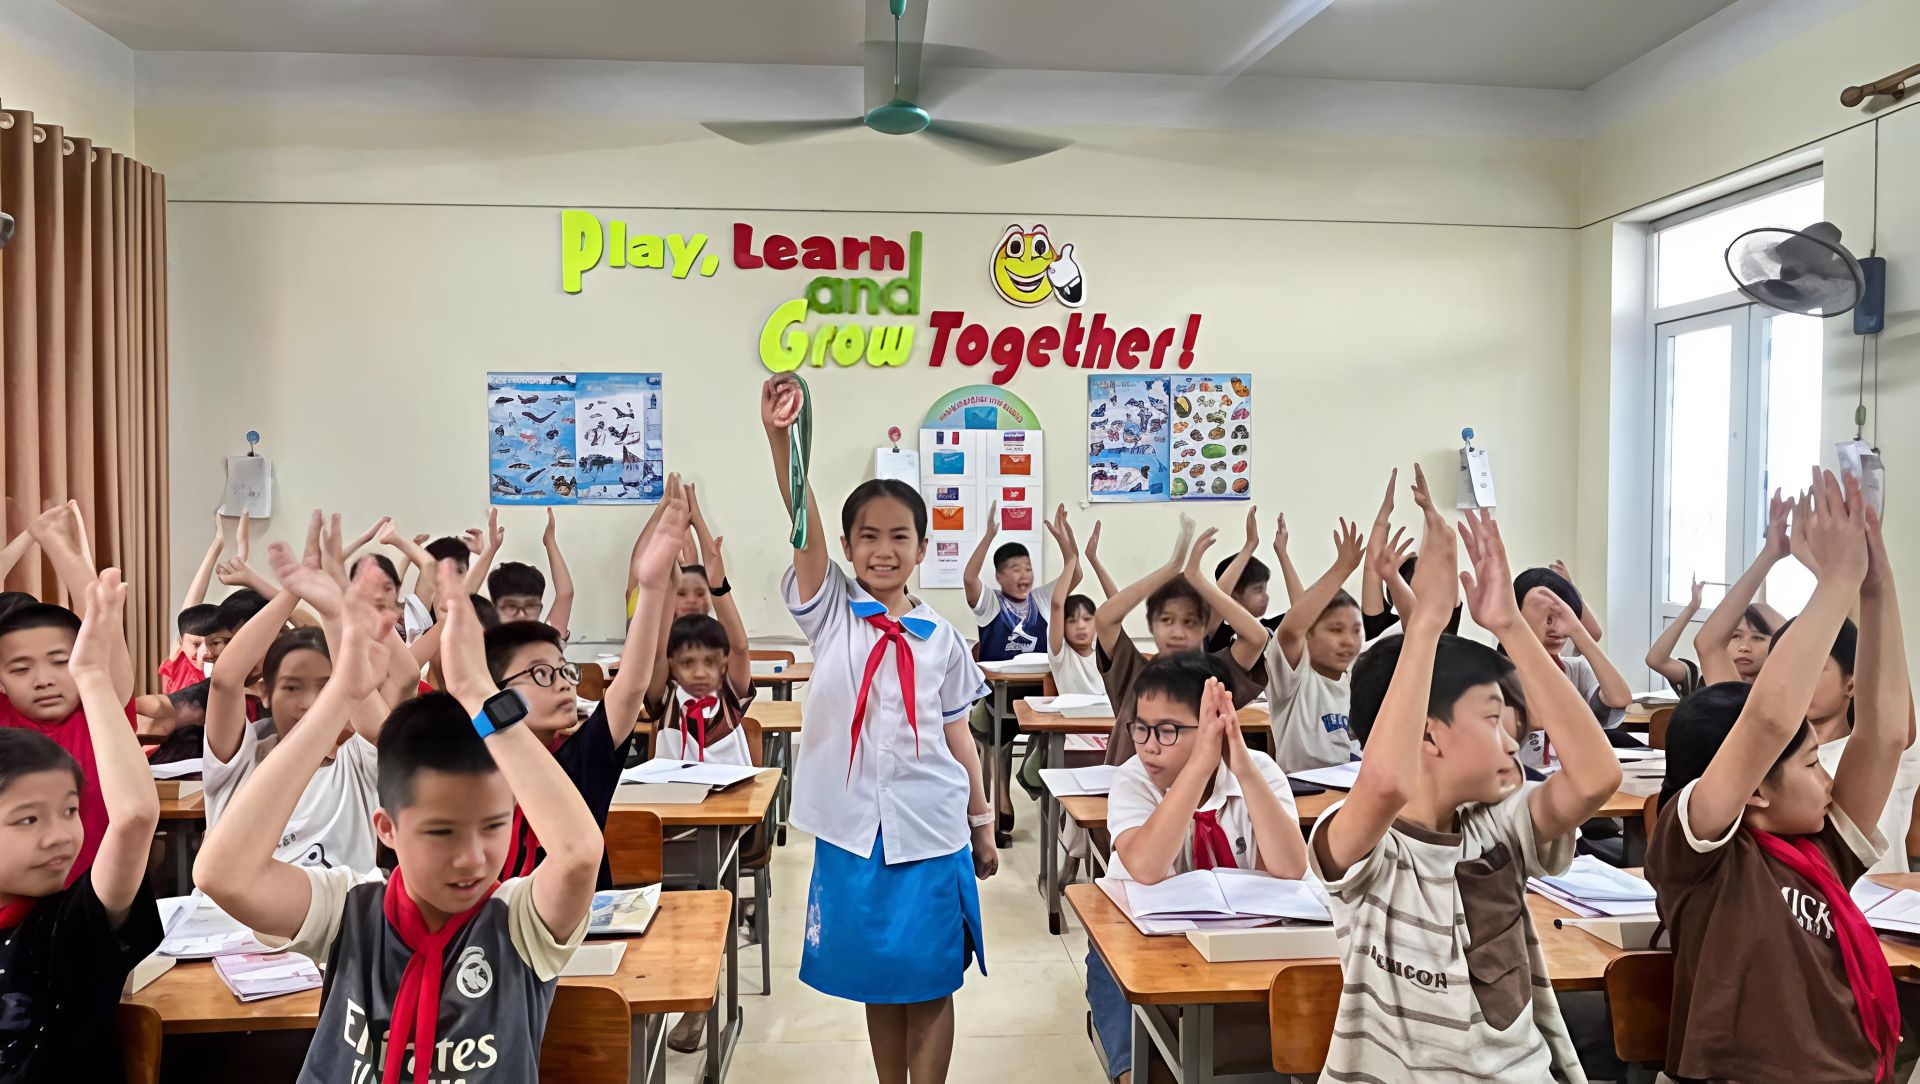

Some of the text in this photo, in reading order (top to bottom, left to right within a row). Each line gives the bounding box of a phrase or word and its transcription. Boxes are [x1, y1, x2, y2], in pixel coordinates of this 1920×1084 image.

[562, 209, 905, 294] Play, Learn
[806, 231, 923, 316] and
[759, 298, 1202, 385] Grow Together!
